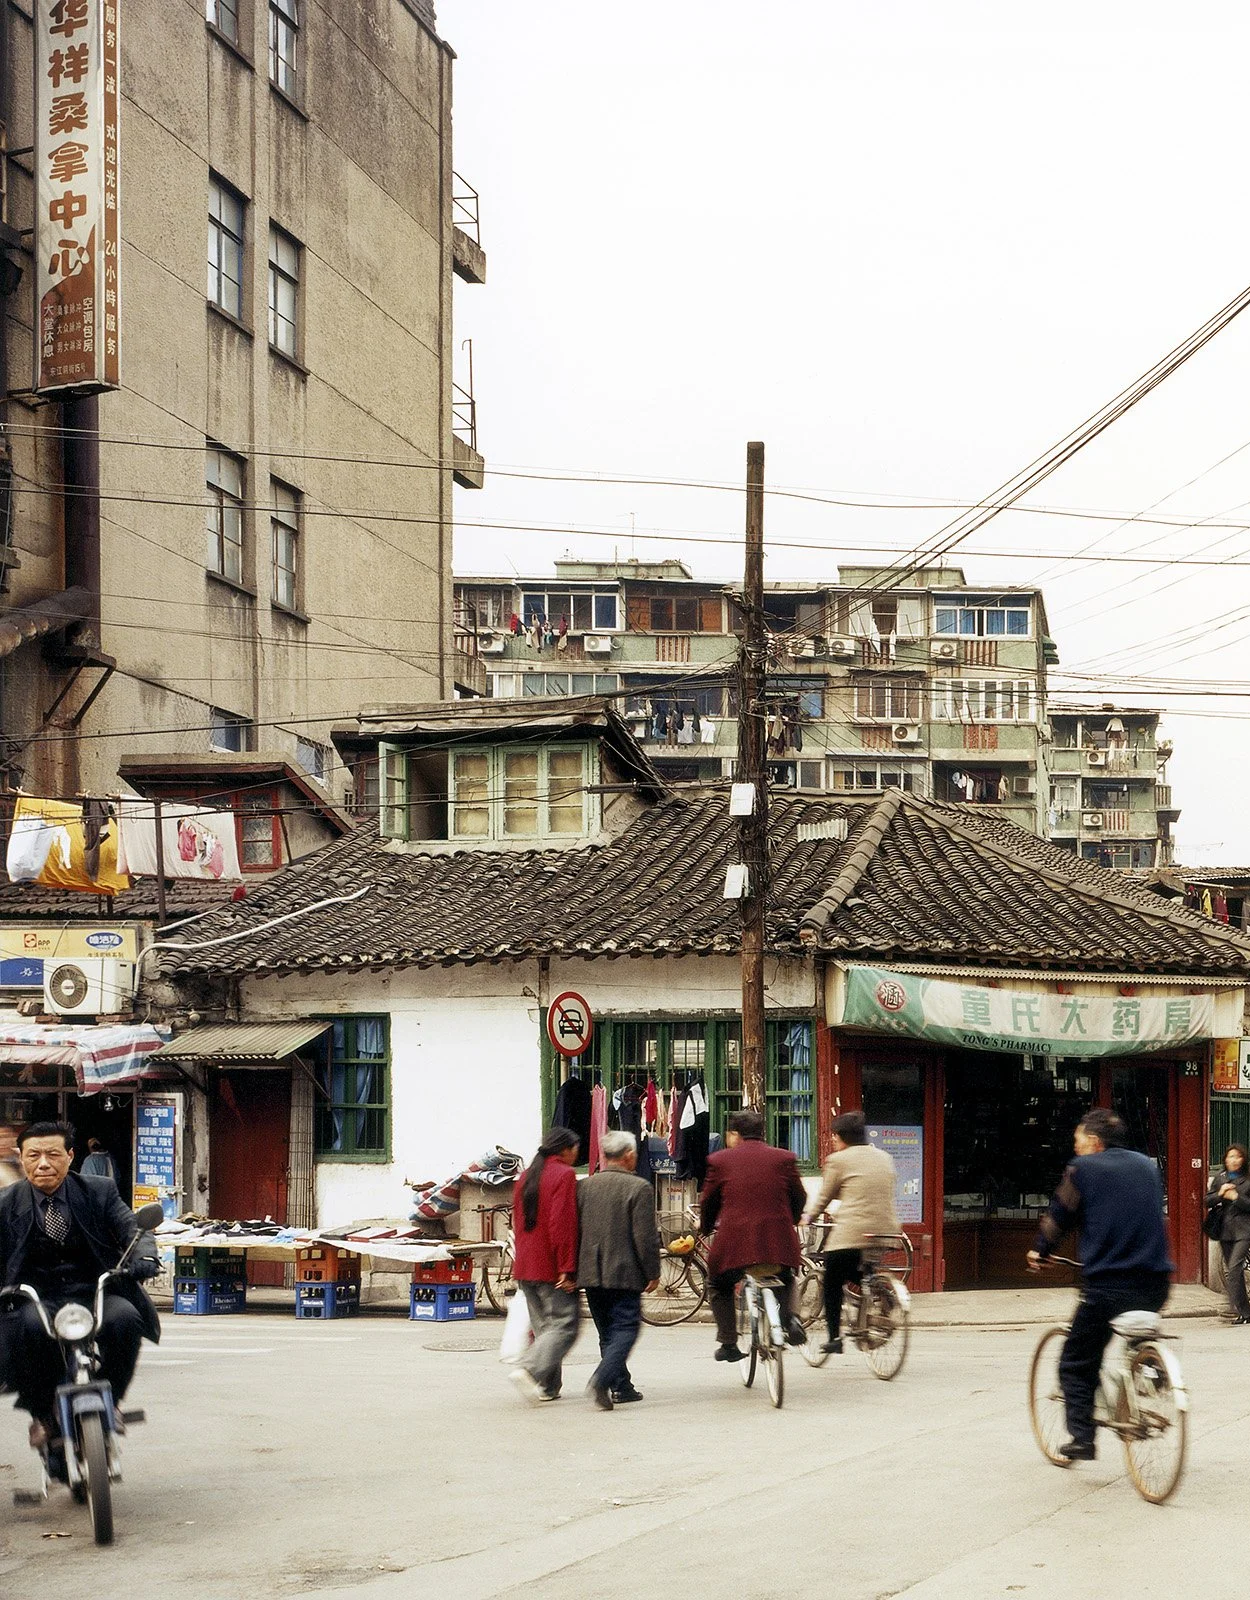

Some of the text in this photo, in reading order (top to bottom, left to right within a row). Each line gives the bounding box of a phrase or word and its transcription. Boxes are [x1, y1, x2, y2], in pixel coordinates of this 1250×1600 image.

[961, 988, 1192, 1036] 童氏大药房
[962, 1034, 1053, 1053] TONG'S PHARMACY
[1185, 1060, 1198, 1071] 98
